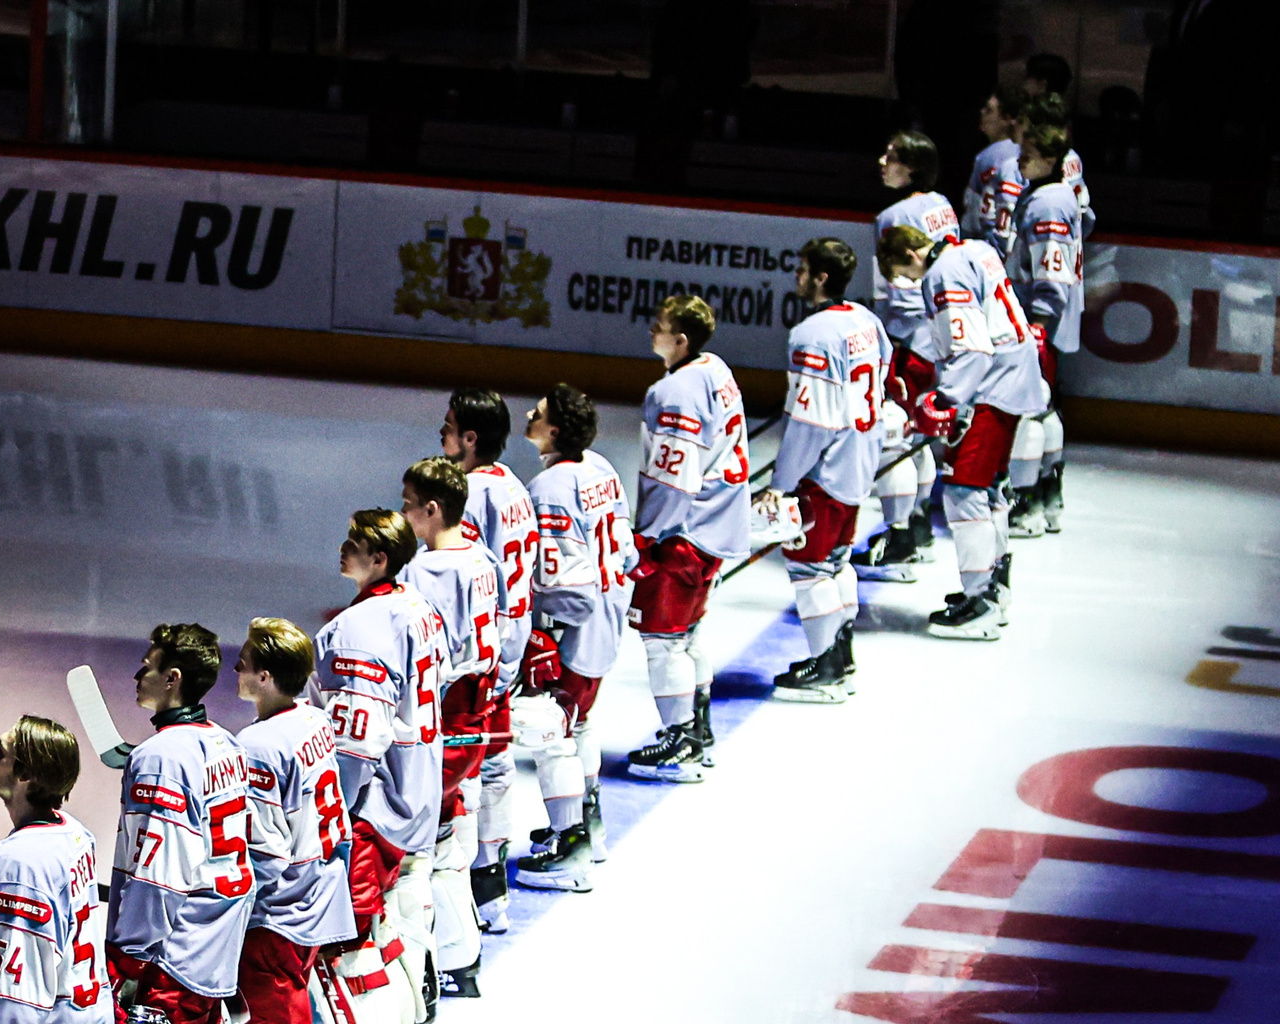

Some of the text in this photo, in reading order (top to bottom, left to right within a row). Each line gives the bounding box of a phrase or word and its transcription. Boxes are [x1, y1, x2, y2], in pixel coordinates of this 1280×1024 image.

[627, 236, 801, 274] ПРАВИТЕЛЬС
[1041, 250, 1062, 272] 49
[1081, 281, 1280, 376] OL
[655, 443, 687, 476] 32
[332, 703, 370, 741] 50
[132, 827, 164, 869] 57
